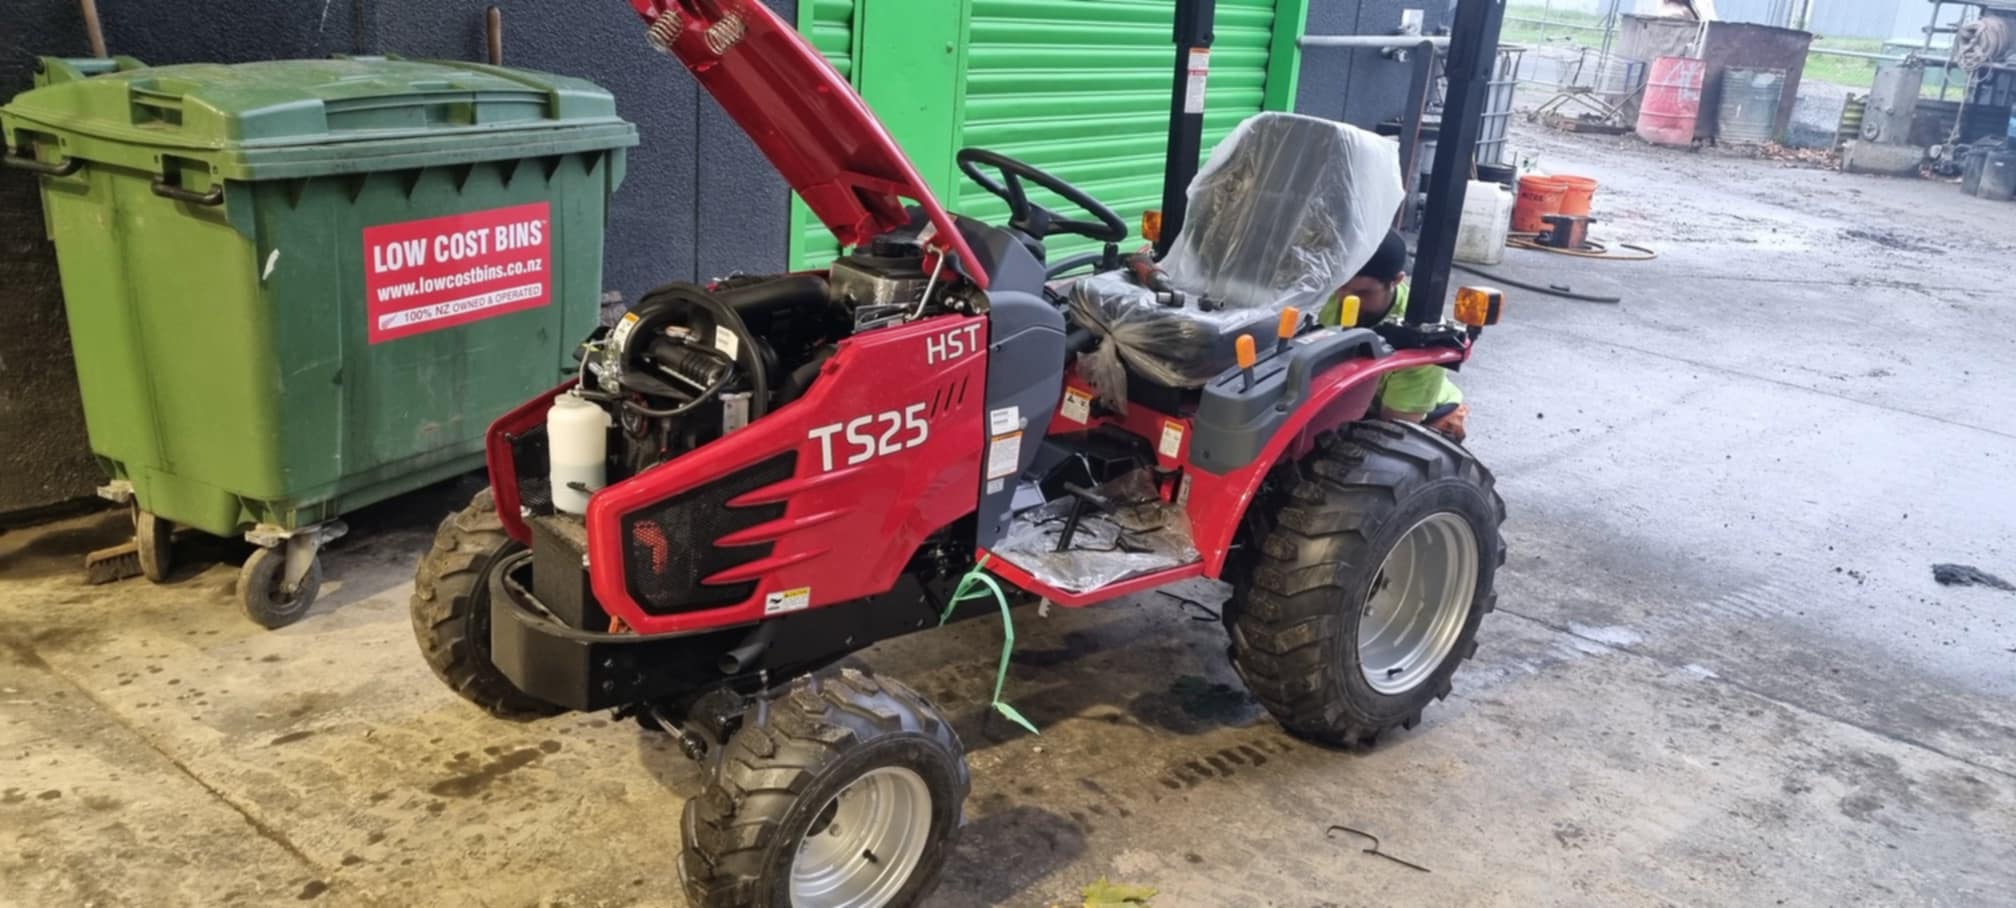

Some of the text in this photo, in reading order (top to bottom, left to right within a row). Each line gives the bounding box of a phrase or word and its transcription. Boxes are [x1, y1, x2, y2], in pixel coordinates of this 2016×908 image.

[373, 220, 542, 273] LOW COST BINS
[377, 258, 542, 302] www.lowcostbins.co.nz
[404, 285, 540, 323] 100% NZ OWNED & OPERATED
[926, 323, 981, 365] HST
[808, 402, 929, 472] TS25
